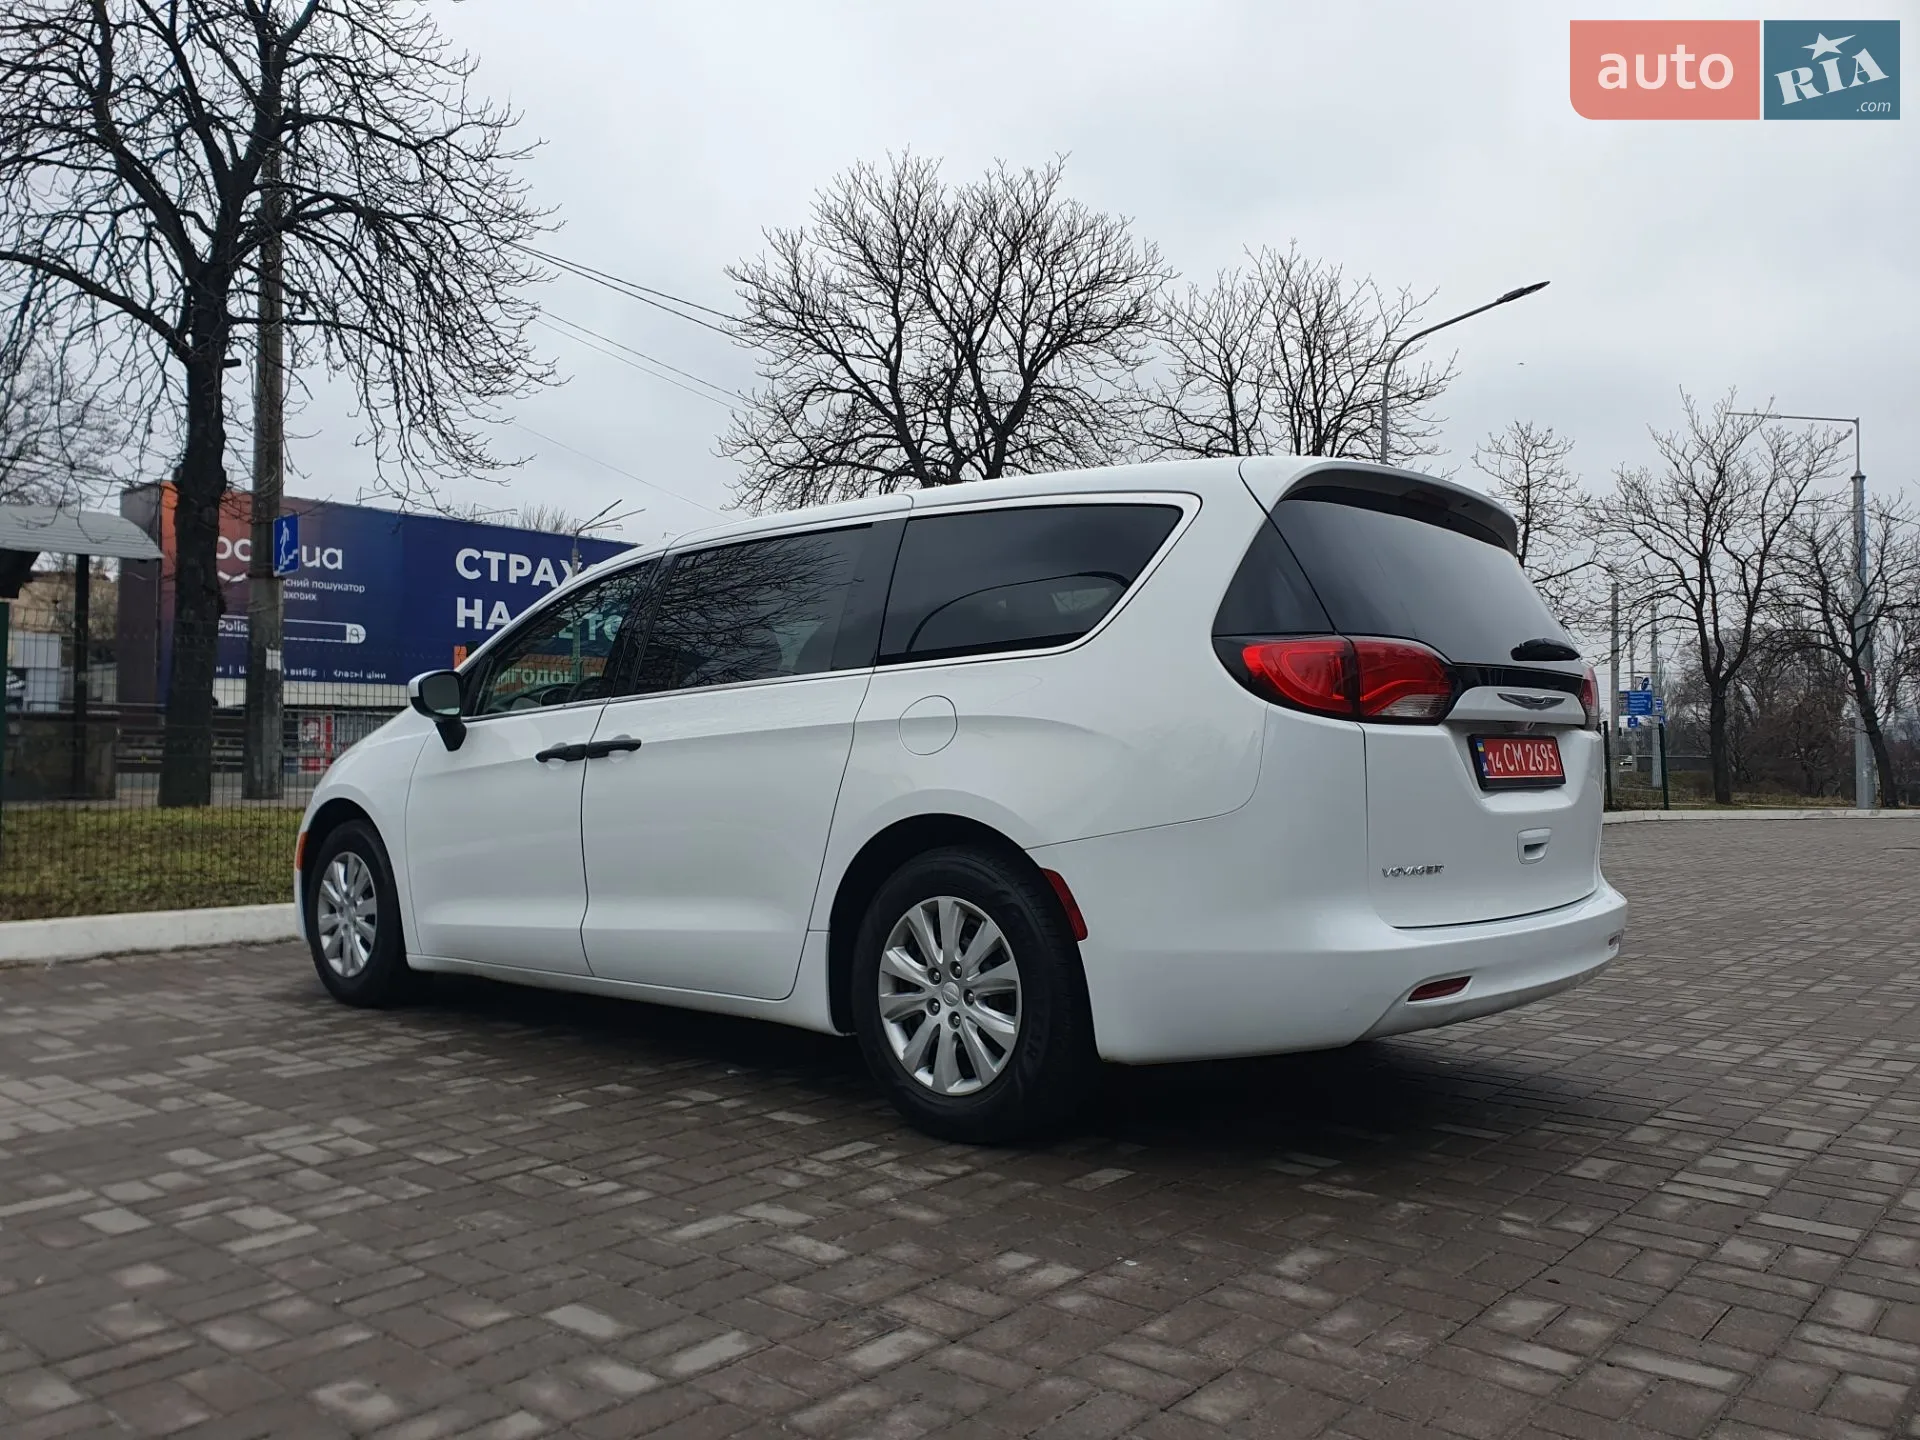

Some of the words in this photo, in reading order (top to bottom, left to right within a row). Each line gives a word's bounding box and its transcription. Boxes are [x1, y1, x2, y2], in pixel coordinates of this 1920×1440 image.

[455, 548, 598, 588] СТРАХ
[283, 577, 309, 588] сний
[312, 580, 365, 593] пошукатор
[456, 597, 512, 630] НА
[1488, 751, 1504, 773] 14
[1526, 743, 1557, 771] 2695
[1381, 865, 1445, 878] VOYAGER
